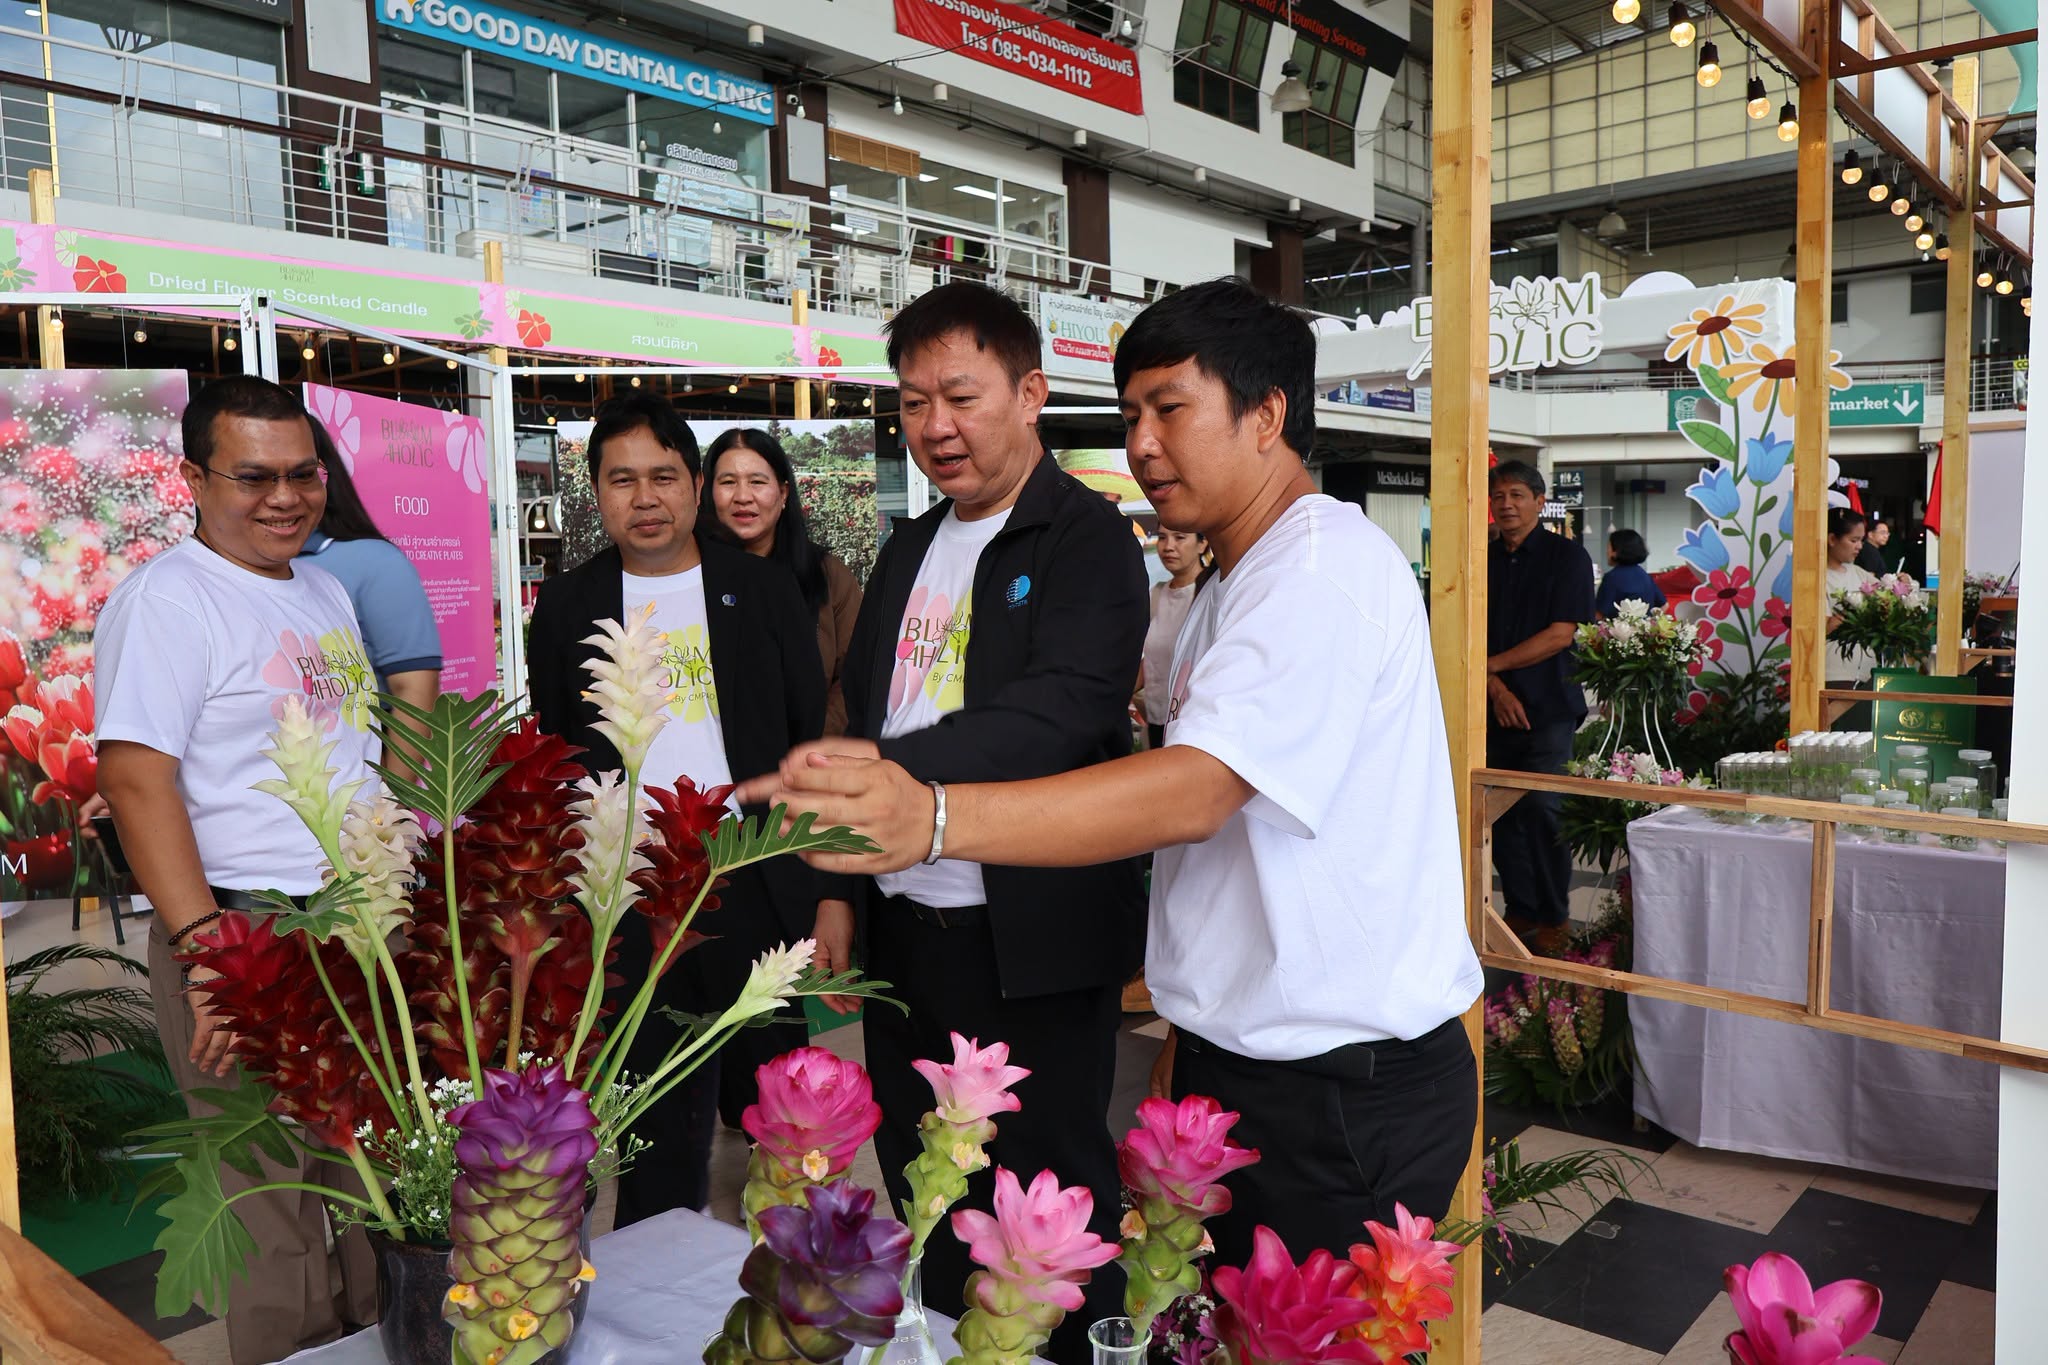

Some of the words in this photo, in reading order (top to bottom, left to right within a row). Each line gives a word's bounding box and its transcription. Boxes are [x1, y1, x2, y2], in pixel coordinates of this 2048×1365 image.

[1278, 2, 1331, 43] Accounting
[1332, 28, 1368, 57] Services
[421, 0, 521, 46] GOOD
[523, 26, 580, 63] DAY
[582, 42, 685, 92] DENTAL
[683, 71, 773, 116] CLINIC
[960, 21, 988, 50] โทร
[990, 37, 1093, 88] 085-034-1112
[148, 271, 206, 292] Dried
[213, 279, 276, 300] Flower
[283, 288, 362, 310] Scented
[367, 297, 428, 317] Candle
[1061, 321, 1104, 343] HIYOU
[1829, 396, 1890, 411] market
[394, 495, 429, 516] FOOD
[1539, 502, 1567, 518] OFFEE
[309, 670, 373, 701] AHOLIC
